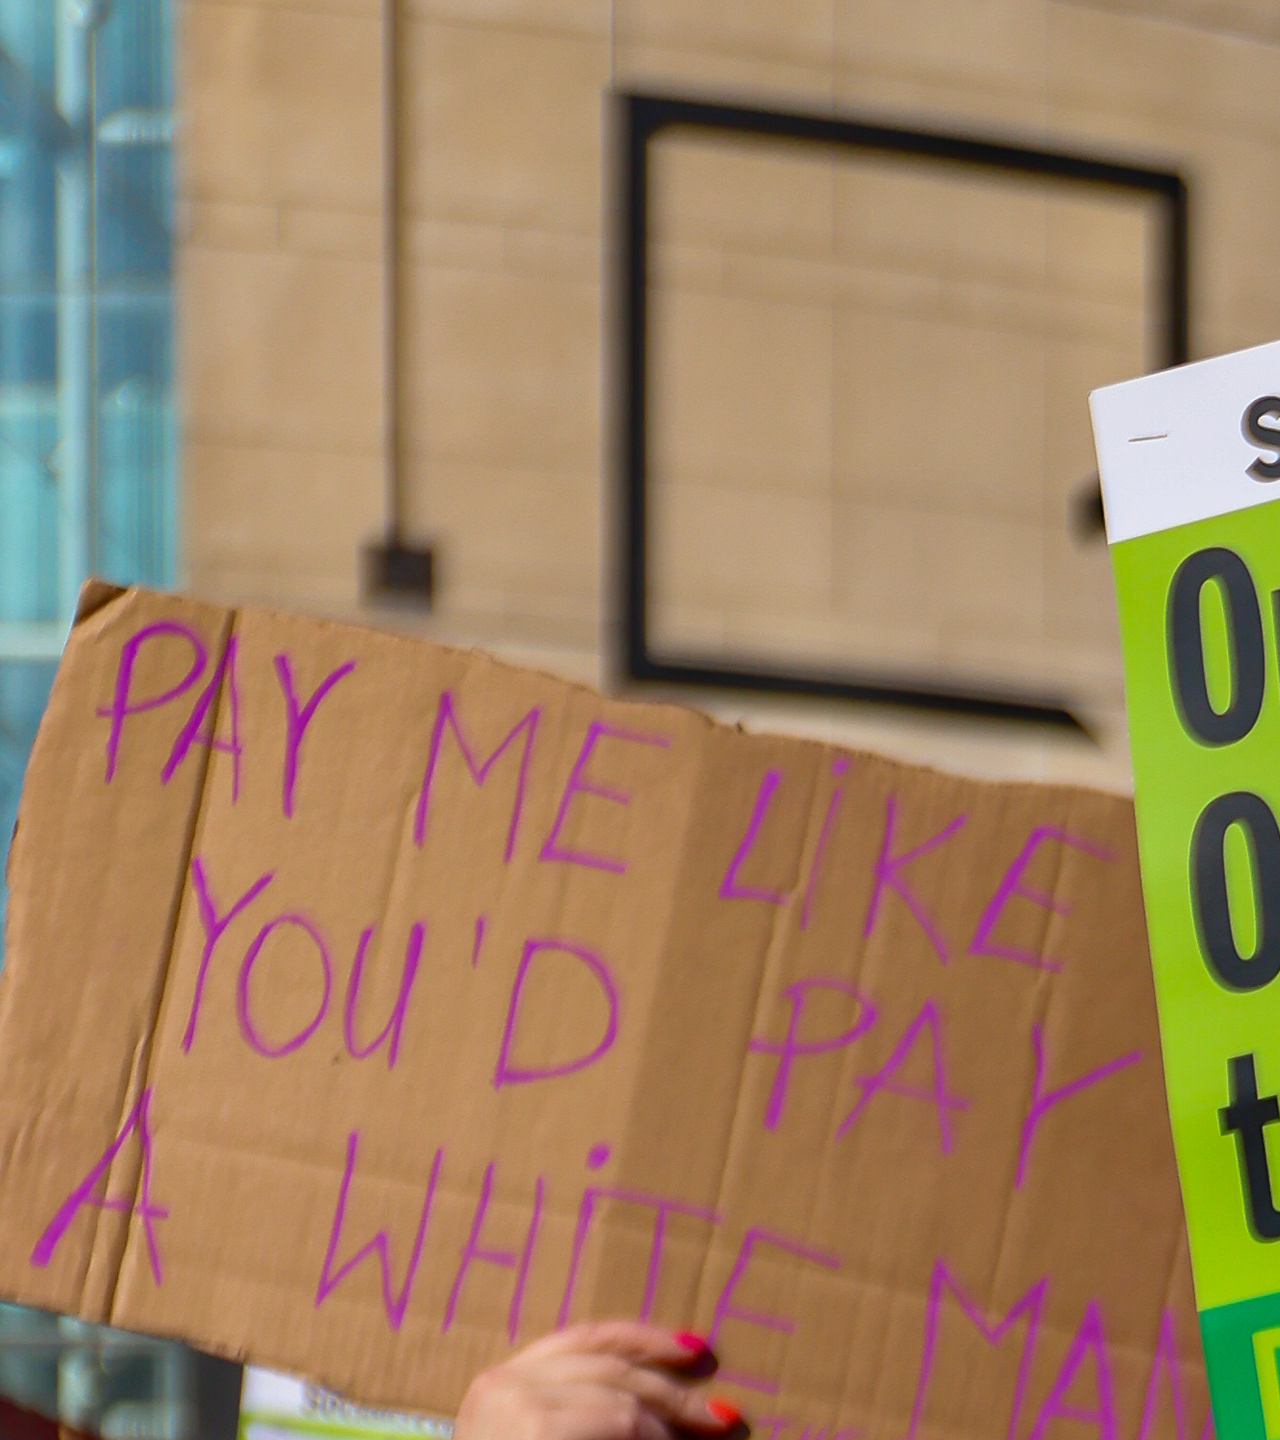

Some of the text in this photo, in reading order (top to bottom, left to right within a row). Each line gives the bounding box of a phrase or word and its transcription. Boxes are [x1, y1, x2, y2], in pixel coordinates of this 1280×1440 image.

[97, 620, 356, 818] PAY
[414, 690, 674, 874] ME
[180, 856, 1143, 1190] YOU'D PAY
[29, 1083, 170, 1285] A
